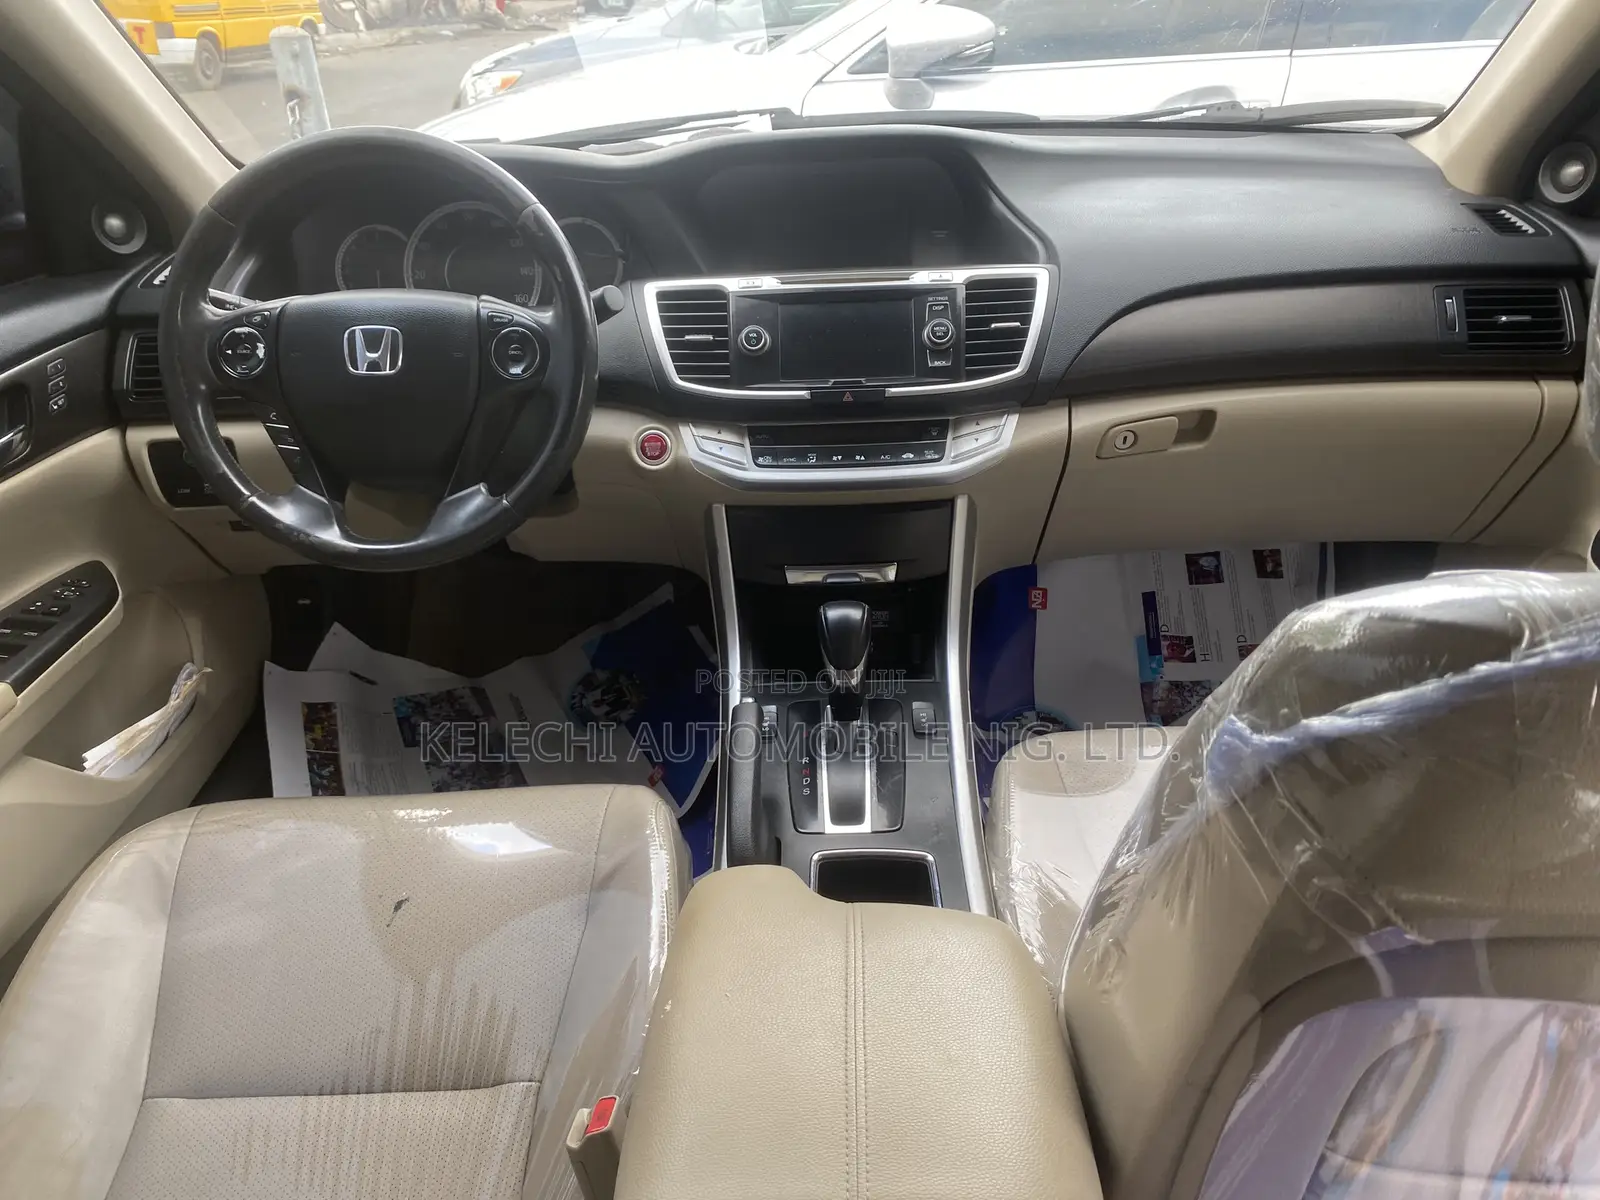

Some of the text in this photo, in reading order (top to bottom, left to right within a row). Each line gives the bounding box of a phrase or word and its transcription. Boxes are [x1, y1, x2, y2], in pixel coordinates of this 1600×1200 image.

[132, 26, 146, 44] T
[514, 294, 529, 303] 160
[802, 757, 810, 765] R
